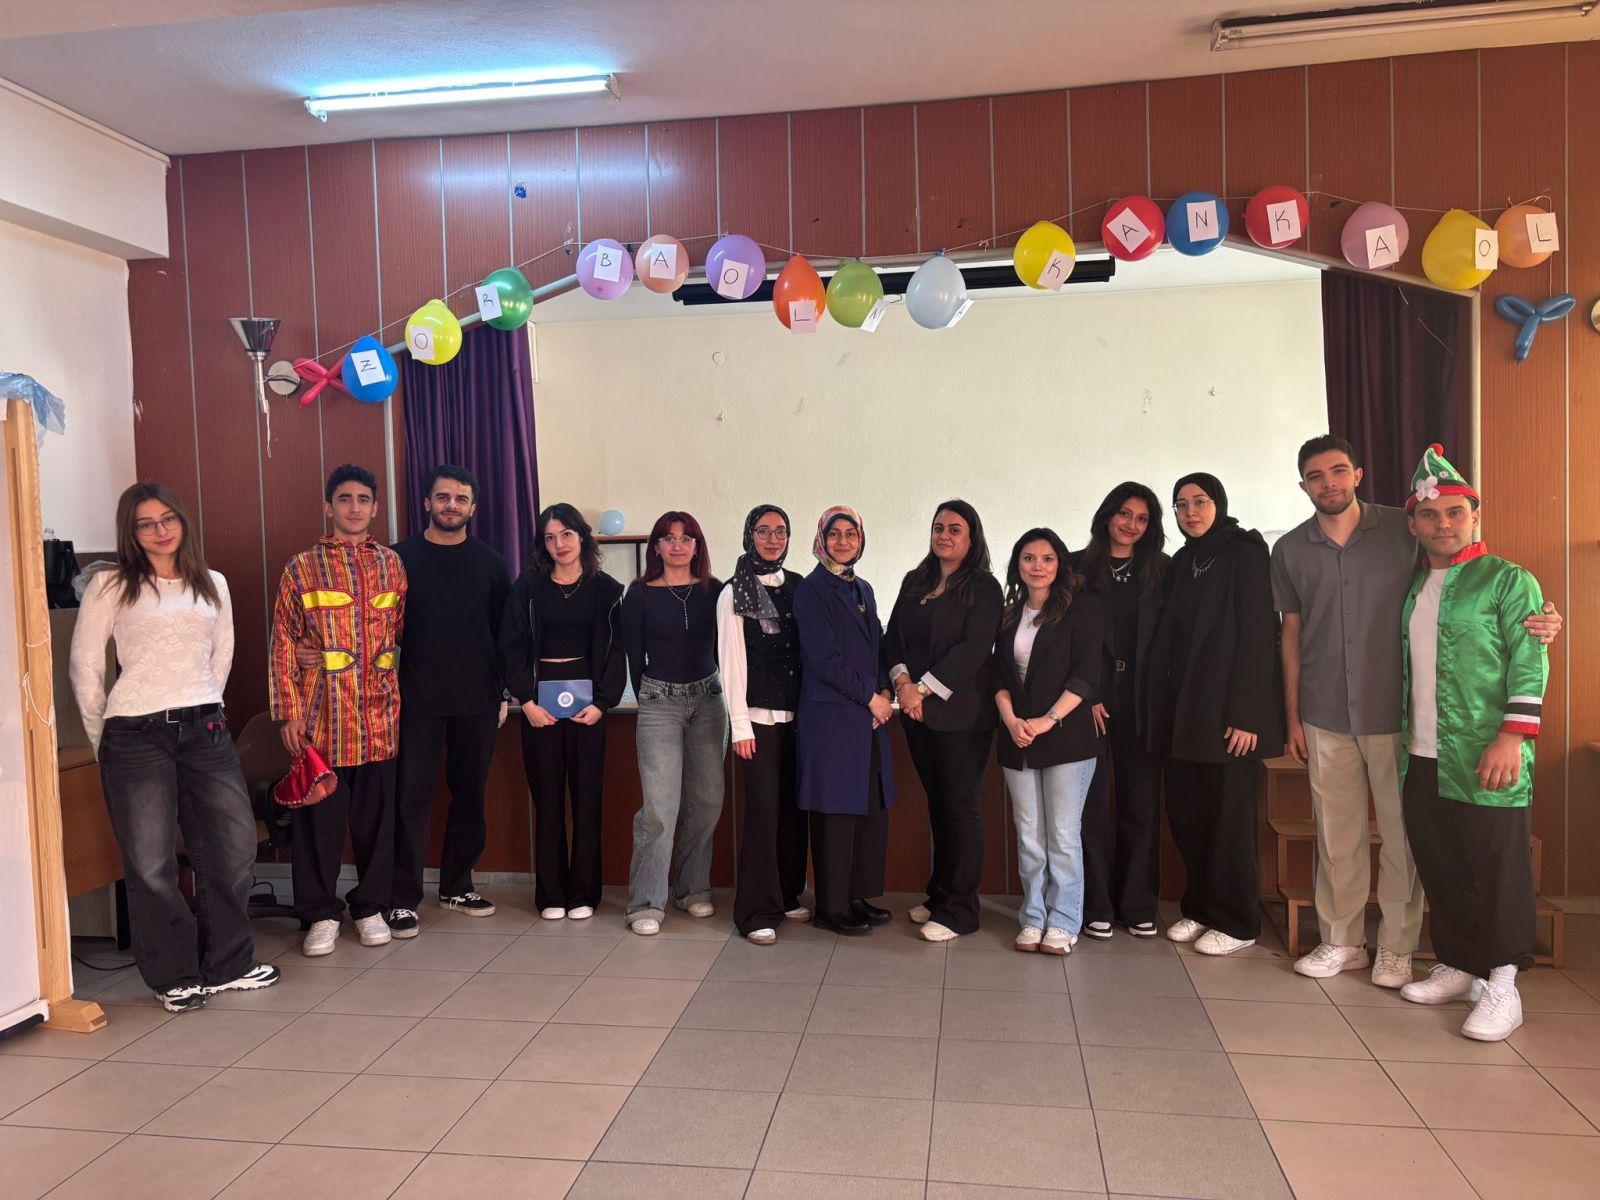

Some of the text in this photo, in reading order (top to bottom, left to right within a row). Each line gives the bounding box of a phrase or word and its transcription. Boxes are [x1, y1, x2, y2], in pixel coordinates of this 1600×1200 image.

[1047, 209, 1391, 279] K A N K A
[1478, 222, 1552, 257] O L
[414, 333, 428, 349] O
[600, 253, 612, 267] B
[653, 250, 669, 269] A
[723, 268, 739, 284] O
[794, 308, 811, 322] L
